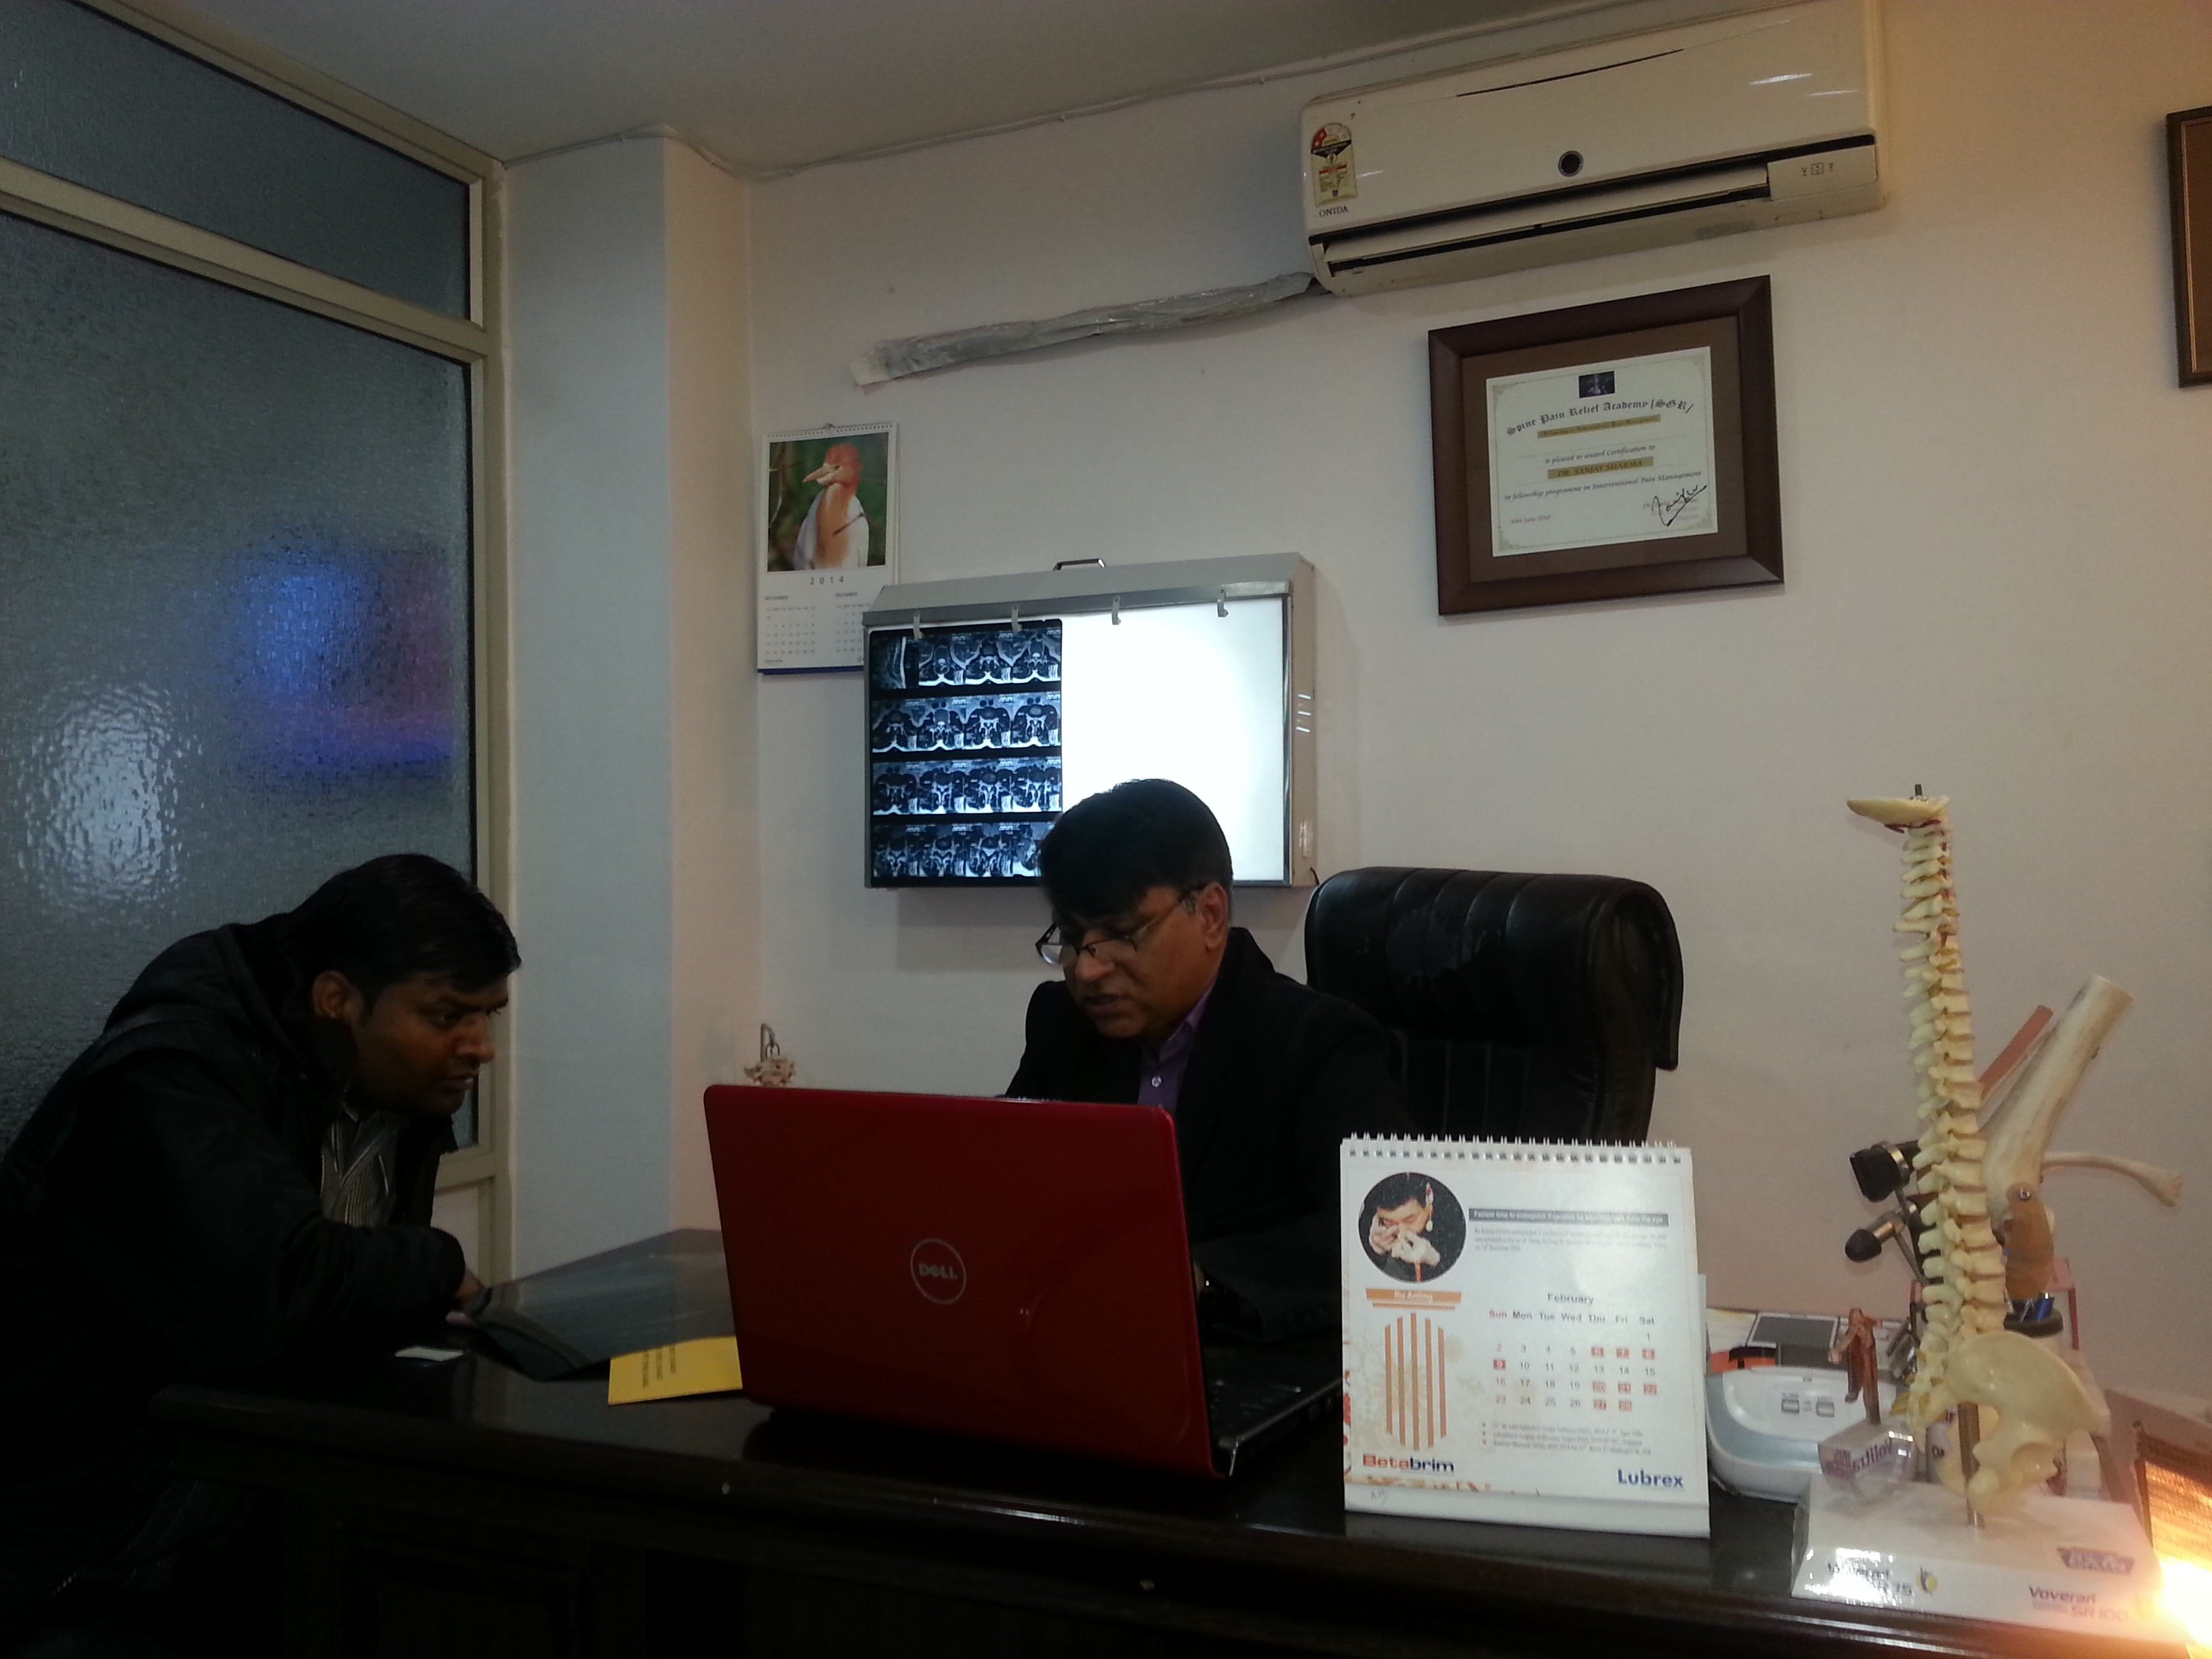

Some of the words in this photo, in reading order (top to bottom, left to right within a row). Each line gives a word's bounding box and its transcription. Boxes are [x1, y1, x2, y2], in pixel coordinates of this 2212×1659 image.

[1319, 205, 1349, 218] ONIDA
[1507, 418, 1536, 436] Spine
[1540, 412, 1565, 424] Pain
[1569, 404, 1599, 416] Relief
[1603, 401, 1648, 411] Academy
[1551, 454, 1575, 466] pleased
[1584, 450, 1605, 459] award
[1607, 445, 1647, 457] Certification
[1605, 459, 1643, 472] SHARMA
[1512, 489, 1544, 502] fellowship
[1545, 485, 1582, 497] programme
[1593, 476, 1639, 490] Interventional
[1640, 474, 1656, 484] Pain
[1657, 470, 1702, 482] Management
[918, 1263, 958, 1281] DELL
[1547, 1293, 1594, 1306] February
[1489, 1309, 1507, 1319] Sun
[1512, 1310, 1532, 1320] Mon
[1540, 1311, 1555, 1321] Tue
[1561, 1313, 1582, 1322] Wed
[1589, 1314, 1605, 1323] Thu
[1615, 1315, 1628, 1324] Fri
[1639, 1316, 1654, 1326] Sat
[1520, 1361, 1530, 1370] 10
[1546, 1361, 1554, 1371] 11
[1570, 1364, 1580, 1373] 12
[1594, 1365, 1604, 1374] 13
[1620, 1366, 1629, 1375] 14
[1645, 1367, 1656, 1376] 15
[1496, 1377, 1506, 1387] 16
[1521, 1378, 1530, 1387] 17
[1546, 1380, 1556, 1389] 18
[1570, 1381, 1580, 1391] 19
[1495, 1395, 1507, 1404] 23
[1520, 1396, 1531, 1406] 24
[1545, 1397, 1556, 1407] 25
[1570, 1398, 1581, 1408] 26
[1363, 1454, 1454, 1472] Betabrim
[1617, 1467, 1685, 1488] Lubrex
